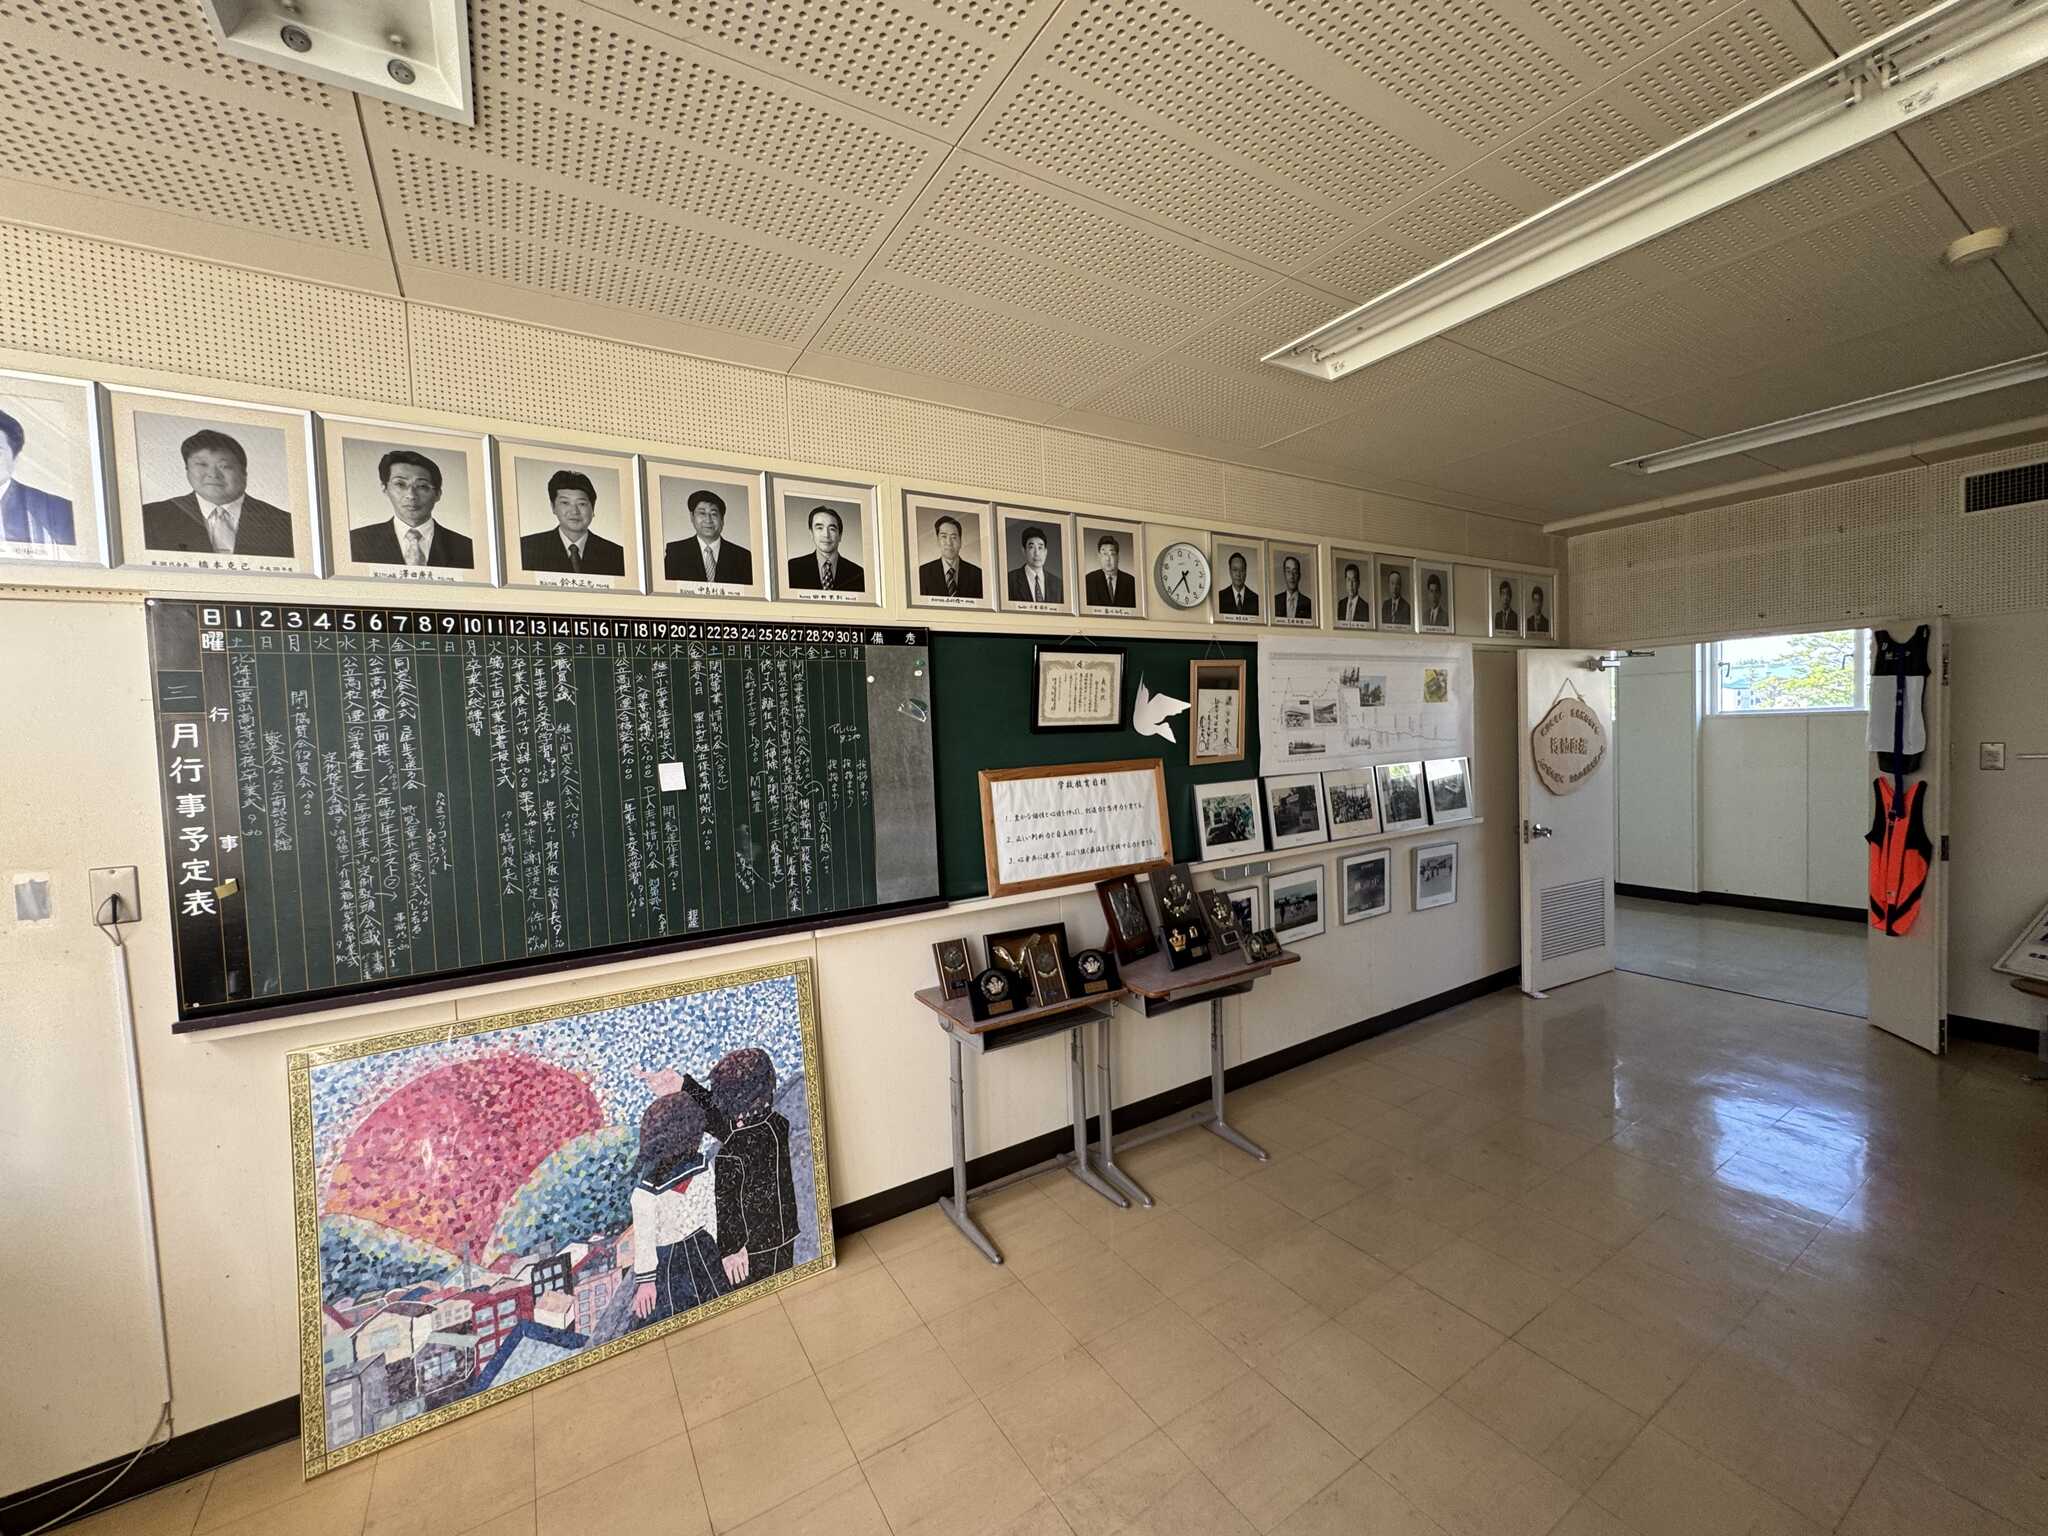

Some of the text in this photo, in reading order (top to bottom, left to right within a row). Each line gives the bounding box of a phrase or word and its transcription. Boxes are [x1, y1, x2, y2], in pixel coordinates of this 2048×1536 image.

[203, 608, 221, 626] 日
[236, 609, 243, 628] 1
[260, 610, 275, 628] 2
[287, 612, 303, 628] 3
[313, 612, 332, 630] 4
[342, 613, 356, 630] 5
[369, 614, 382, 631] 6
[392, 616, 408, 631] 7
[418, 616, 432, 632] 8
[441, 617, 455, 634] 9
[464, 617, 481, 634] 10
[488, 618, 503, 634] 11
[510, 619, 526, 635] 12
[531, 620, 547, 635] 13
[553, 621, 570, 636] 14
[575, 621, 589, 636] 15
[593, 622, 609, 637] 16
[614, 623, 628, 637] 17
[634, 623, 648, 637] 18
[653, 623, 667, 638] 19
[670, 624, 687, 638] 20
[689, 625, 703, 638] 21
[707, 626, 721, 639] 22
[723, 627, 738, 639] 23
[741, 628, 756, 640] 24
[758, 628, 773, 640] 25
[775, 629, 789, 641] 26
[790, 629, 804, 641] 27
[806, 630, 820, 642] 28
[821, 630, 835, 643] 29
[836, 631, 850, 643] 30
[852, 631, 864, 643] 31
[202, 631, 225, 652] 曜
[227, 636, 252, 649] 土
[260, 635, 273, 649] 日
[288, 634, 299, 652] 月
[313, 635, 332, 650] 火
[338, 635, 357, 651] 水
[367, 637, 385, 652] 木
[390, 636, 416, 651] 金
[416, 640, 435, 651] 土
[445, 639, 455, 652] 日
[465, 639, 477, 656] 月
[488, 640, 504, 655] 火
[510, 639, 527, 655] 水
[532, 640, 546, 655] 木
[553, 641, 570, 655] 金
[575, 644, 588, 655] 土
[596, 644, 605, 655] 日
[617, 642, 626, 657] 月
[635, 642, 647, 656] 火
[652, 642, 666, 657] 水
[670, 643, 685, 658] 木
[707, 645, 723, 657] 土
[727, 645, 736, 656] 日
[744, 644, 752, 659] 月
[759, 645, 771, 657] 火
[775, 645, 789, 658] 水
[791, 645, 804, 659] 木
[806, 646, 820, 658] 金
[822, 649, 835, 659] 土
[839, 648, 847, 658] 日
[852, 647, 859, 660] 月
[170, 722, 217, 918] 月行事予定表
